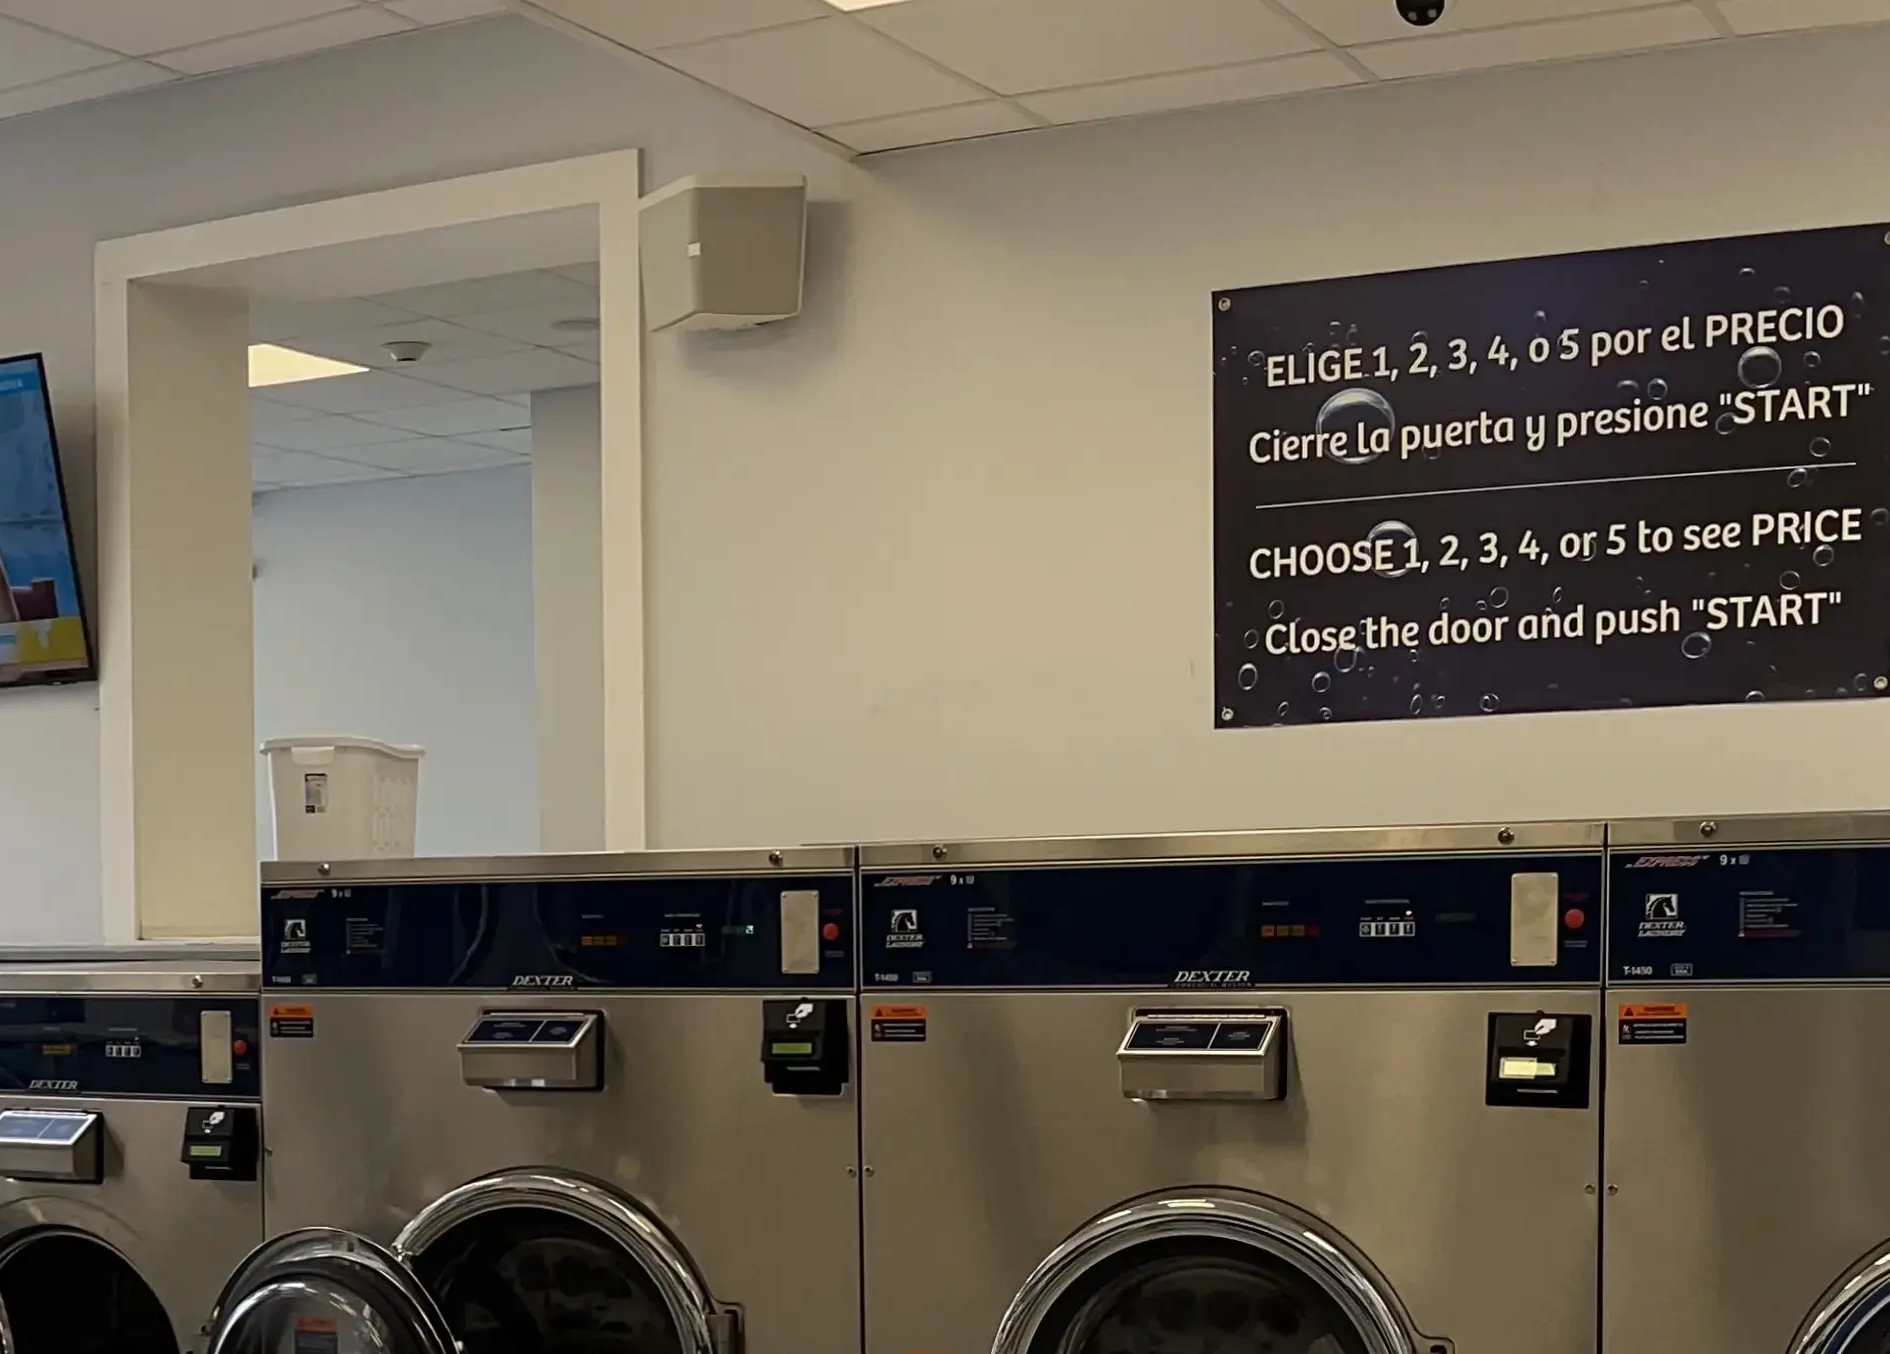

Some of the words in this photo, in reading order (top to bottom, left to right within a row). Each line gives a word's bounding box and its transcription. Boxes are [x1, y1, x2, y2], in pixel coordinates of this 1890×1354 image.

[1267, 347, 1363, 387] ELIGE
[1372, 346, 1399, 377] 1,
[1408, 342, 1438, 374] 2,
[1448, 338, 1477, 370] 3,
[1487, 335, 1518, 371] 4,
[1529, 337, 1550, 363] o
[1559, 328, 1580, 360] 5
[1591, 327, 1652, 367] por
[1661, 316, 1695, 352] el
[1706, 304, 1844, 350] PRECIO
[1249, 429, 1348, 463] Cierre
[1358, 422, 1390, 454] la
[1401, 411, 1514, 460] puerta
[1526, 415, 1545, 452] y
[1557, 398, 1709, 447] presione
[1720, 383, 1872, 425] "START"
[1250, 538, 1394, 579] CHOOSE
[1403, 537, 1430, 574] 1,
[1439, 535, 1470, 571] 2,
[1479, 532, 1509, 569] 3,
[1518, 530, 1549, 566] 4,
[1559, 532, 1598, 558] or
[1606, 523, 1626, 555] 5
[1638, 520, 1673, 553] to
[1683, 522, 1741, 551] see
[1752, 508, 1862, 546] PRICE
[1265, 622, 1357, 655] Close
[1365, 616, 1420, 649] the
[1428, 612, 1510, 645] door
[1518, 604, 1584, 640] and
[1595, 599, 1680, 645] push
[1692, 591, 1841, 632] "START"
[1719, 855, 1728, 866] 9
[1638, 921, 1685, 930] DEXTER
[511, 974, 575, 987] DEXTER
[1173, 969, 1252, 983] DEXTER
[28, 1079, 79, 1091] DEXTER
